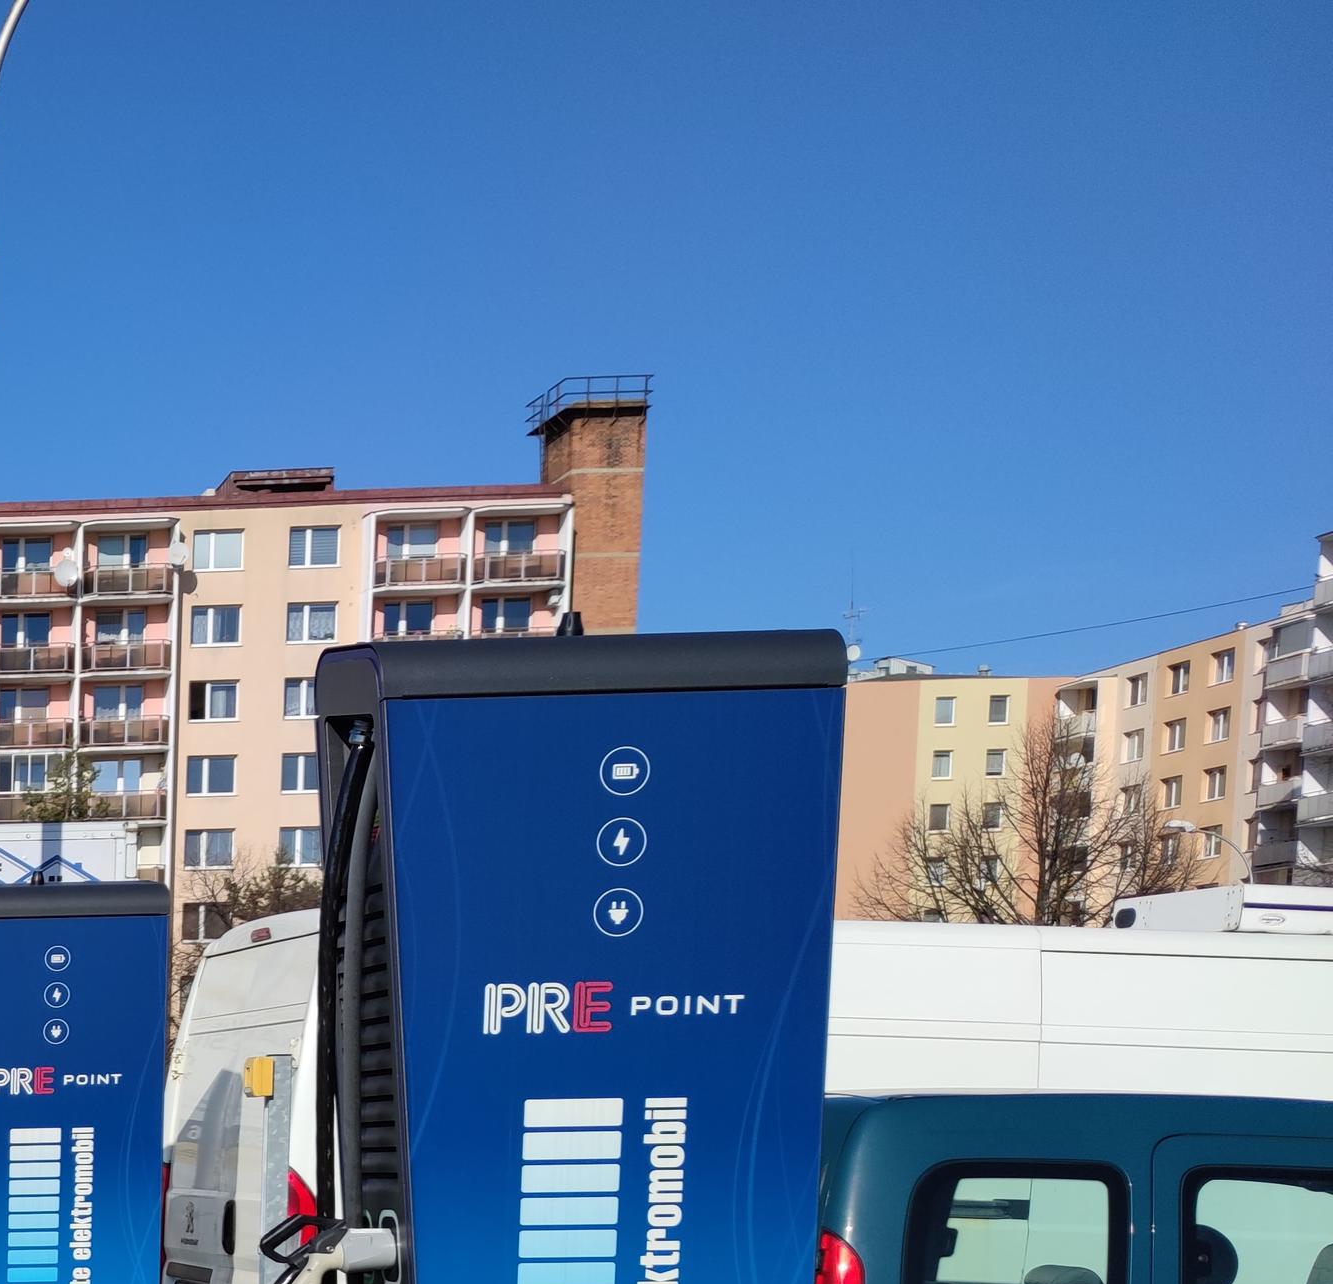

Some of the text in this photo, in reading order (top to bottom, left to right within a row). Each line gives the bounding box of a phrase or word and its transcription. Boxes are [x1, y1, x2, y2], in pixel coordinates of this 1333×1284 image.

[483, 981, 746, 1035] PRE POINT
[63, 1073, 122, 1086] POINT
[70, 1127, 95, 1261] elektromobil
